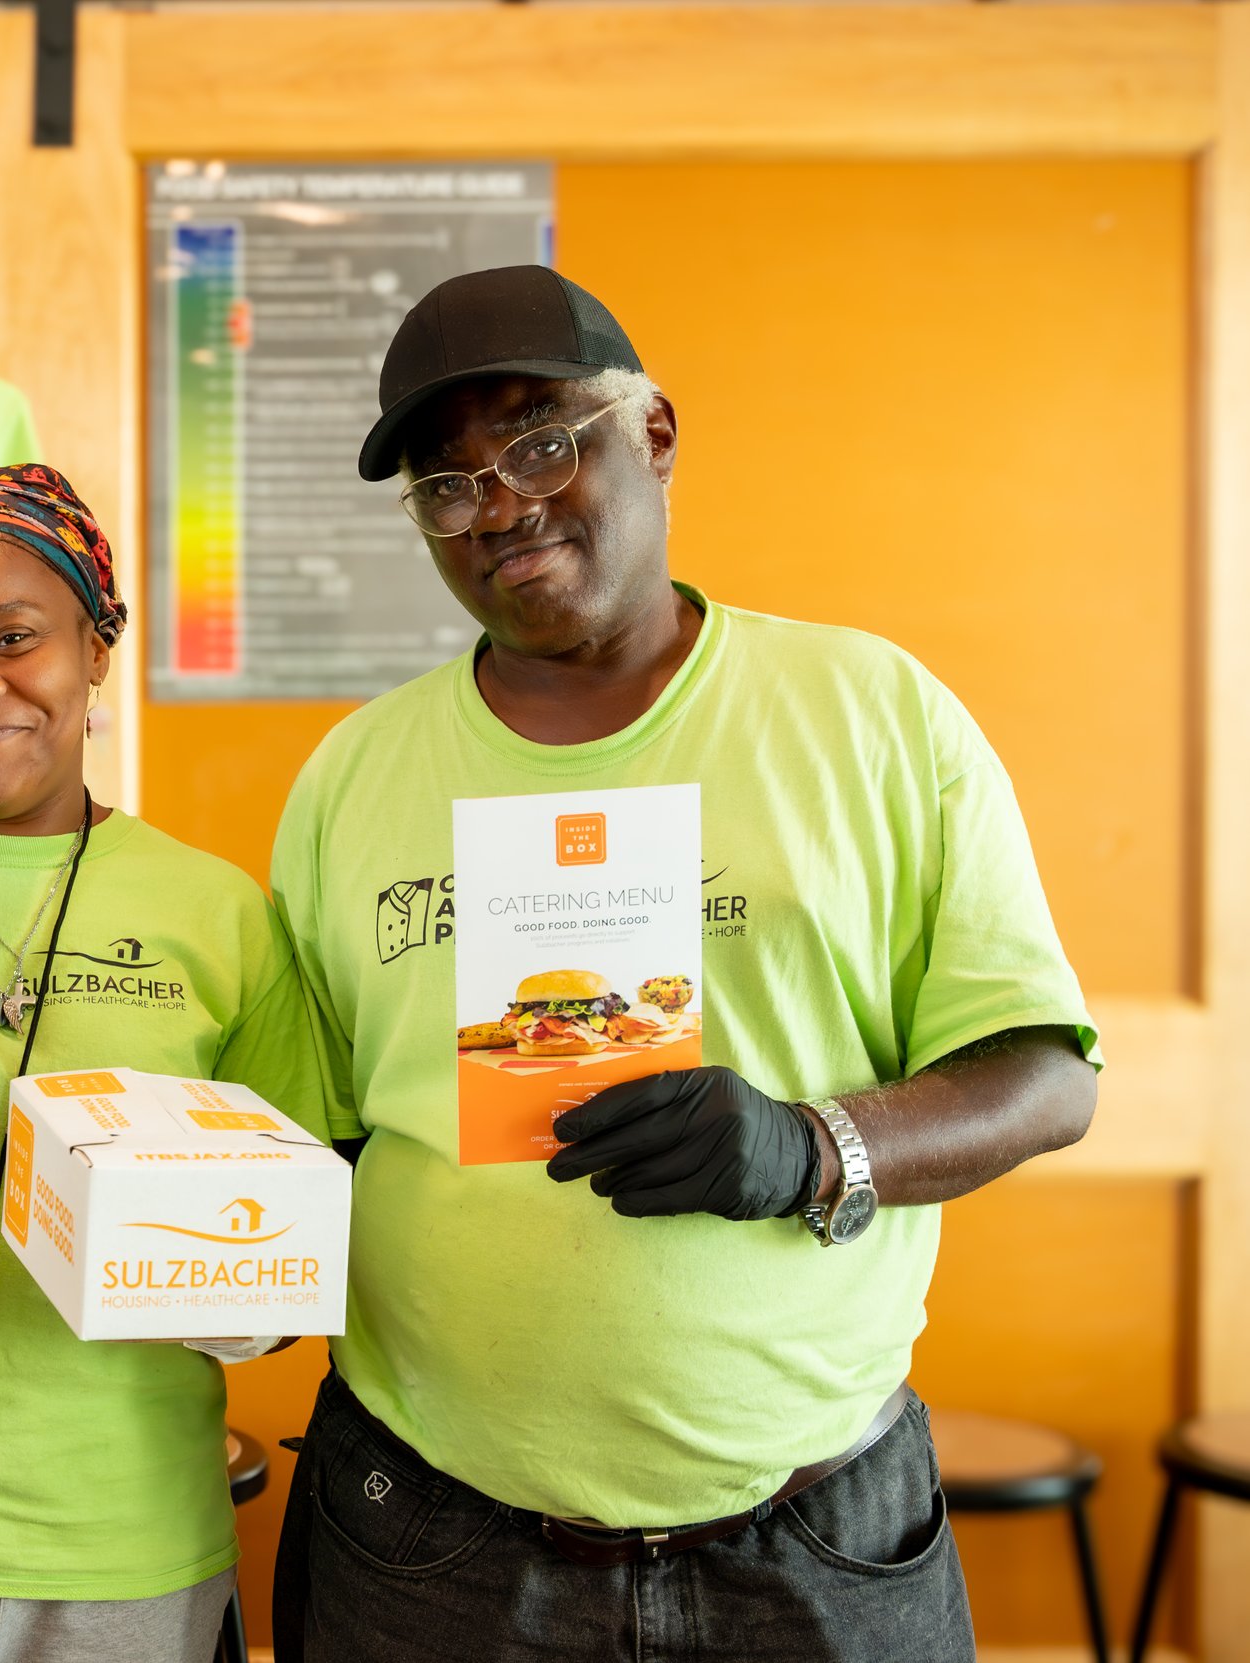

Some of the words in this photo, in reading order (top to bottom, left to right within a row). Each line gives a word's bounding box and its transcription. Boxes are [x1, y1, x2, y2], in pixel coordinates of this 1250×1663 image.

[565, 825, 597, 833] INSIDE
[565, 843, 597, 854] BOX
[487, 891, 601, 916] CATERING
[608, 886, 674, 908] MENU
[514, 924, 545, 932] GOOD
[548, 921, 580, 930] FOOD.
[583, 918, 617, 928] DOING
[619, 915, 652, 925] GOOD.
[715, 925, 746, 937] HOPE
[82, 995, 149, 1009] HEALTHCARE
[158, 1002, 187, 1011] HOPE
[56, 1079, 77, 1093] BOX
[12, 1138, 29, 1163] INSIDE
[134, 1152, 292, 1161] ITBSJAX.ORG
[14, 1161, 24, 1179] THE
[9, 1178, 25, 1211] BOX
[36, 1174, 55, 1210] GOOD
[54, 1196, 76, 1237] FOOD.
[33, 1199, 54, 1240] DOING
[54, 1225, 76, 1266] GOOD.
[102, 1258, 319, 1290] SULZBACHER
[101, 1295, 171, 1310] HOUSING
[184, 1292, 270, 1308] HEALTHCARE
[282, 1291, 319, 1305] HOPE
